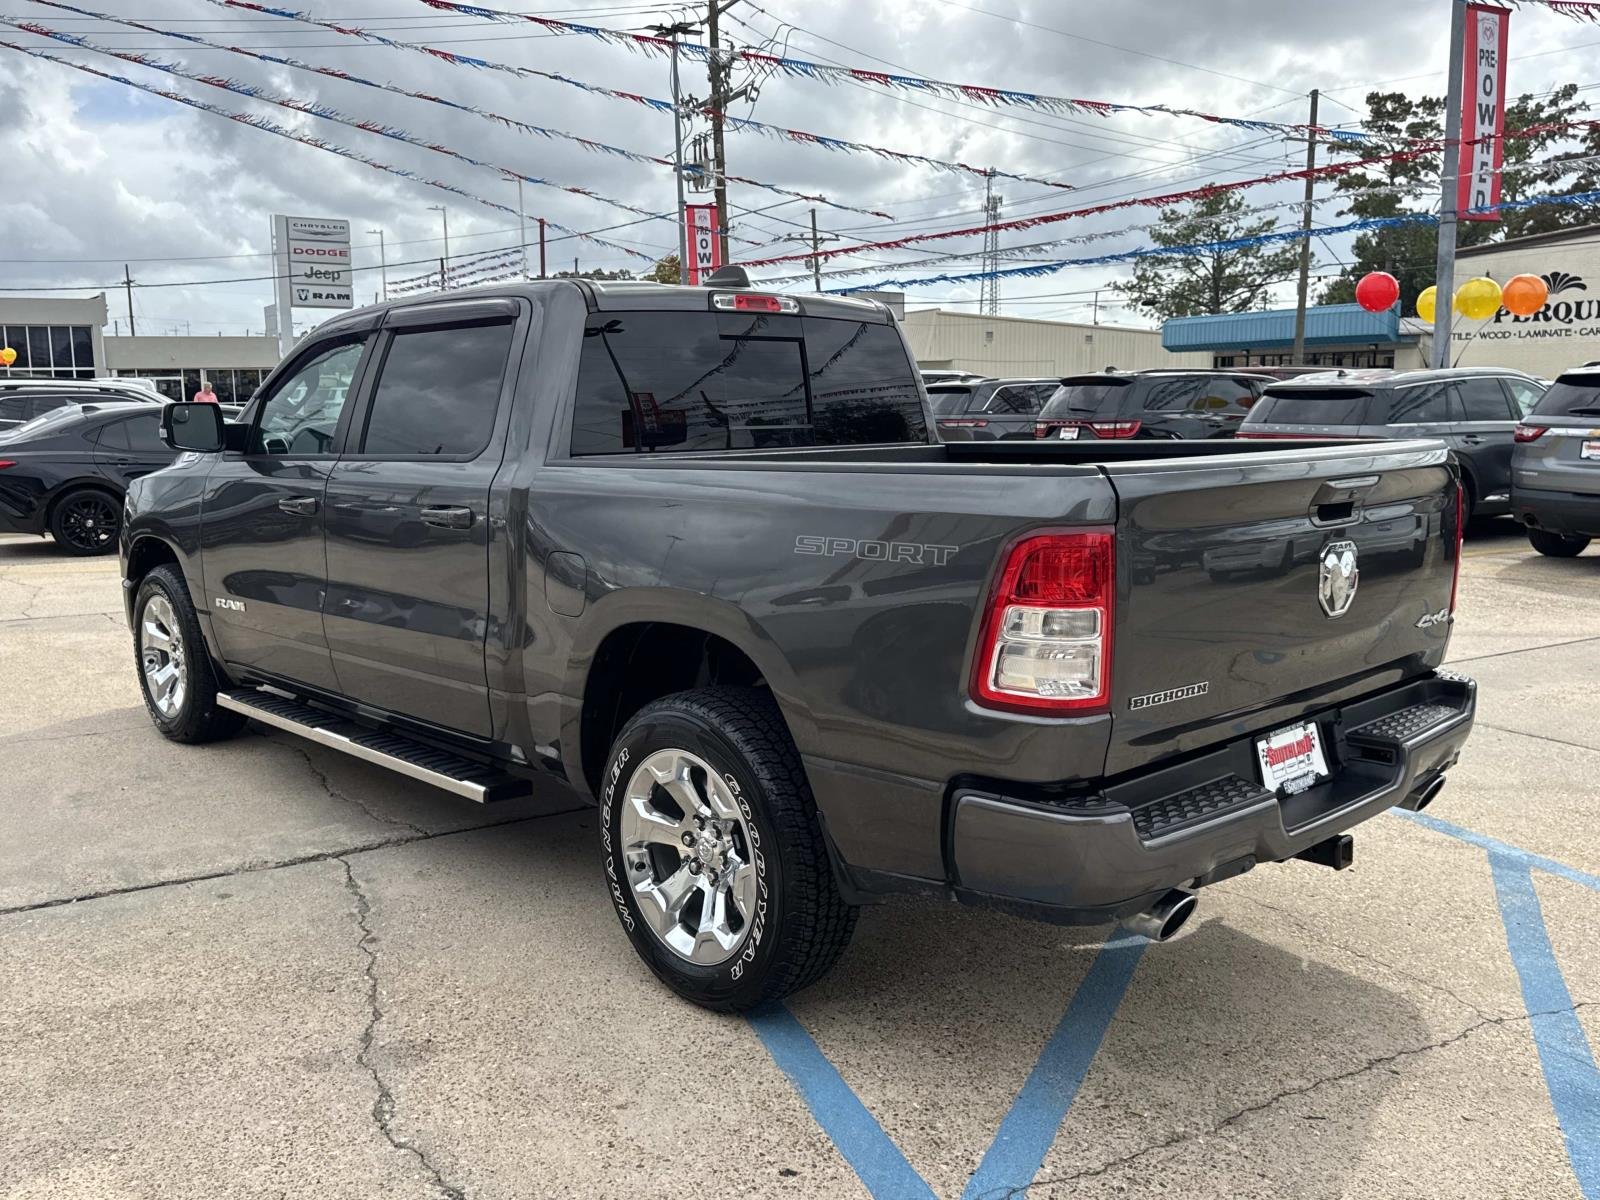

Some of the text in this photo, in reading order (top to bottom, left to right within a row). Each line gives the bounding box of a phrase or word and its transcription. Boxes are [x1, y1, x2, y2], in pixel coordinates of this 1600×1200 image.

[1475, 74, 1496, 211] OWNED
[293, 222, 345, 230] CHRYSLER
[293, 247, 349, 257] DODGE
[698, 238, 712, 283] OWN
[304, 266, 341, 282] Jeep
[312, 292, 351, 301] RAM
[1450, 331, 1473, 341] TILE
[1479, 330, 1511, 340] WOOD
[1518, 328, 1572, 339] LAMINATE
[793, 535, 960, 566] SPORT
[215, 597, 247, 612] RAM
[1129, 681, 1209, 710] BIGHORN
[601, 747, 635, 933] WRANGLER
[725, 773, 768, 980] GOODYEAR
